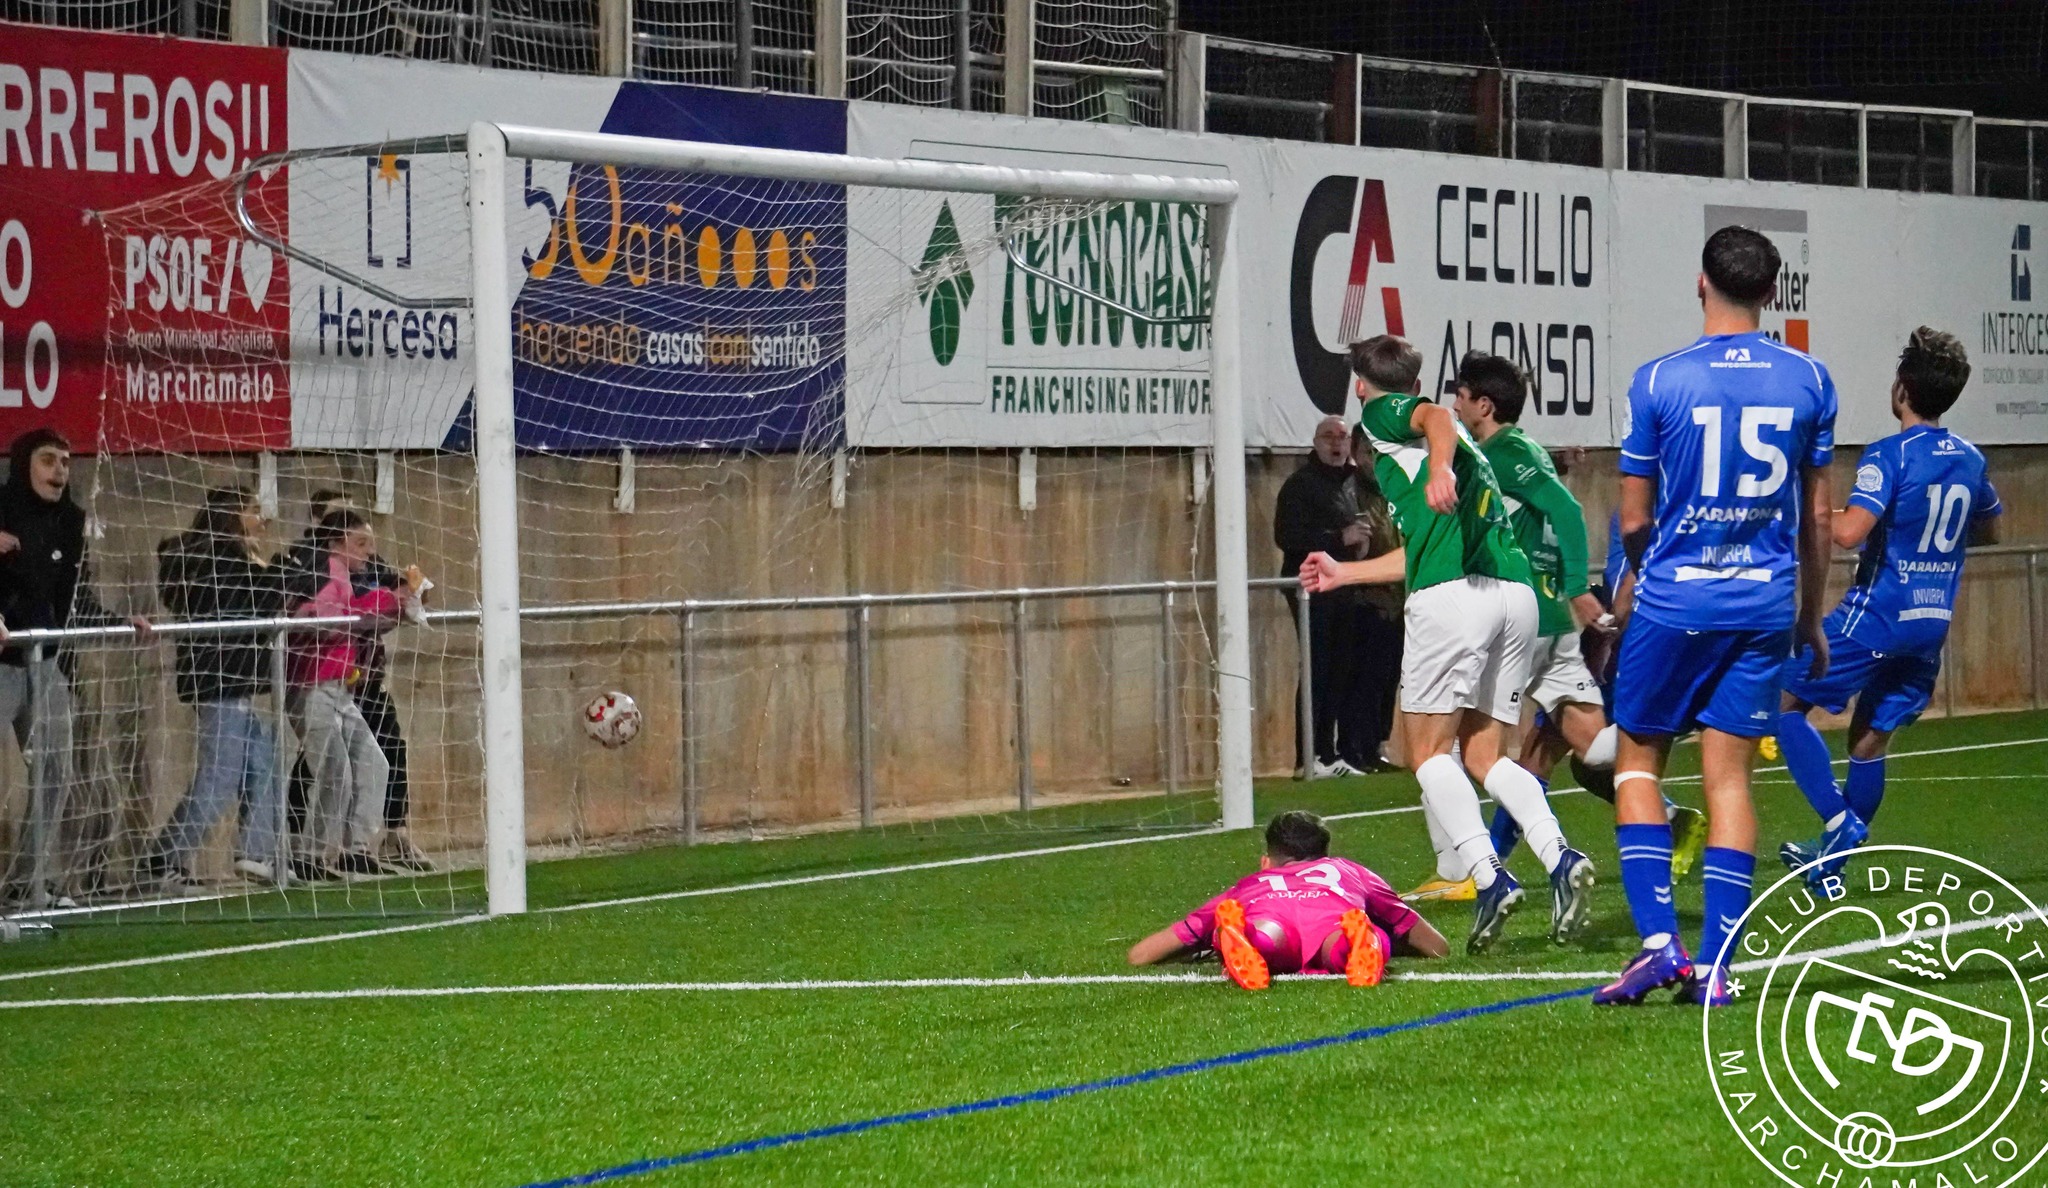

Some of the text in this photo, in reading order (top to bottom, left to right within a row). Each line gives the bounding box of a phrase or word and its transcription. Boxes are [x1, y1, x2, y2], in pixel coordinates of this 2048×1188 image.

[1436, 184, 1593, 288] CECILIO
[127, 328, 274, 351] Grupo Municipal Socialista
[319, 285, 459, 361] Hercesa
[519, 304, 641, 366] haciendo
[646, 331, 704, 366] casas
[752, 321, 820, 368] sentido
[126, 361, 274, 403] Marchamalo
[992, 375, 1130, 415] FRANCHISING
[1691, 405, 1795, 498] 15
[1917, 483, 1972, 554] 10
